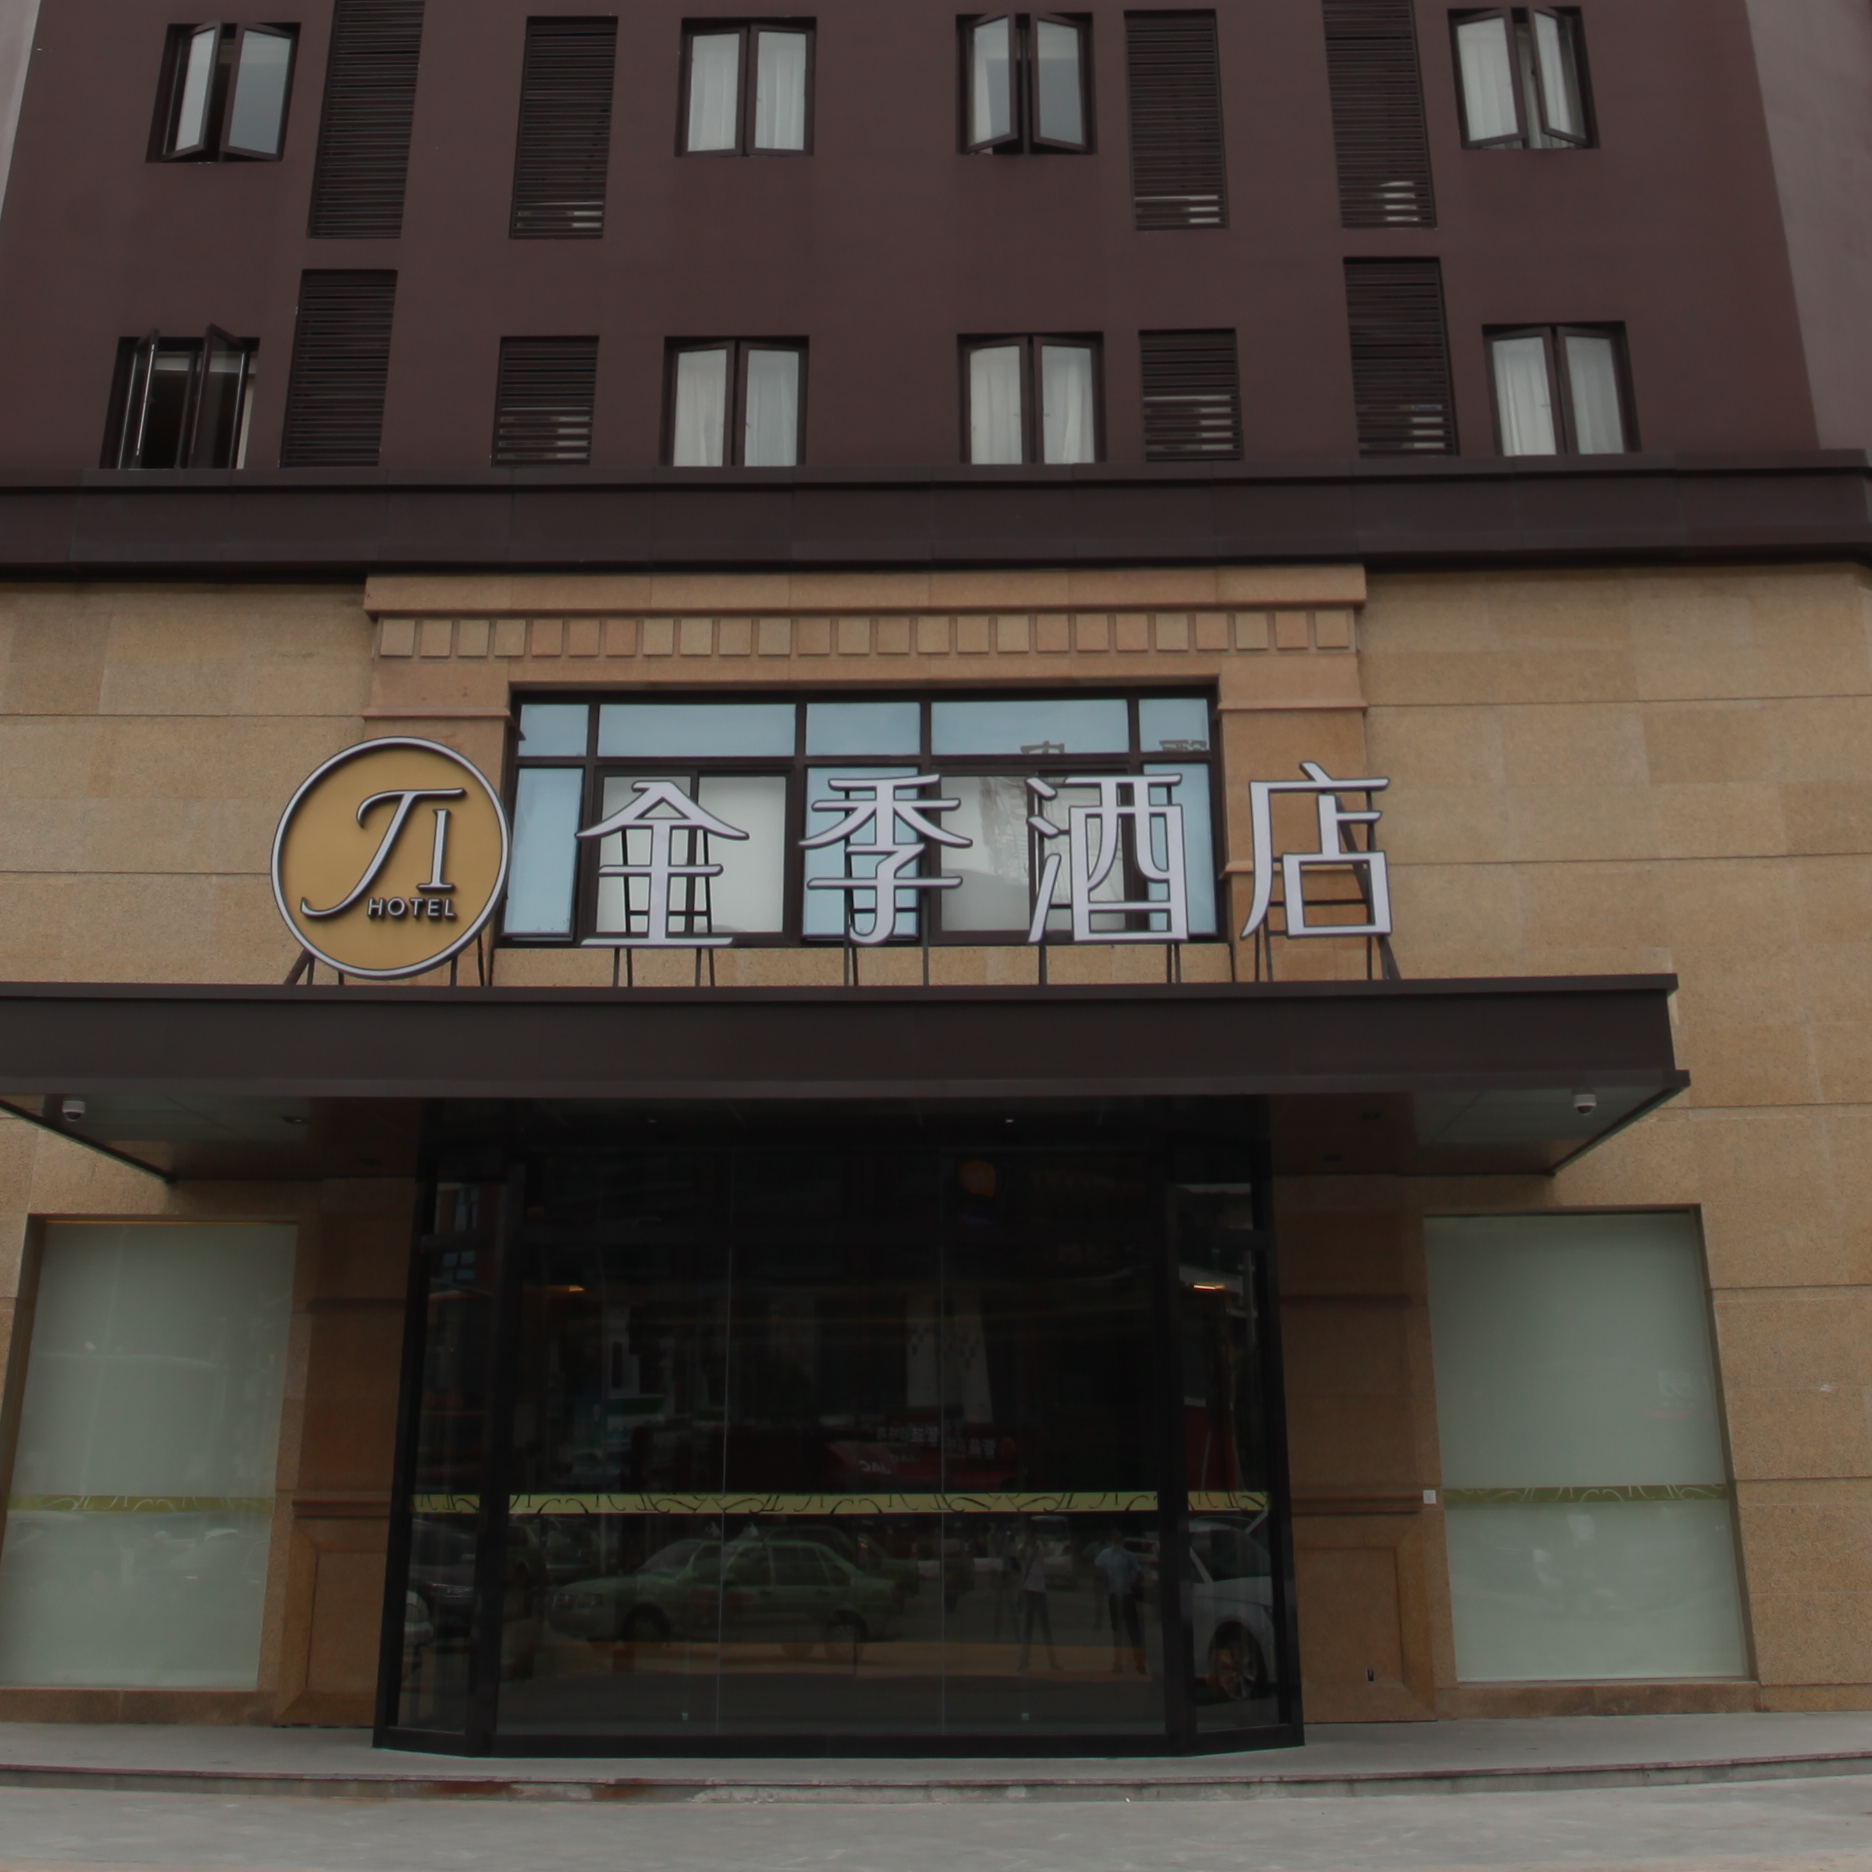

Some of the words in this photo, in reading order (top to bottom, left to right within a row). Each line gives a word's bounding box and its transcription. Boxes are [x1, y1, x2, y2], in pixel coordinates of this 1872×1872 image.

[575, 760, 1393, 947] 全季酒店
[367, 897, 457, 919] HOTEL
